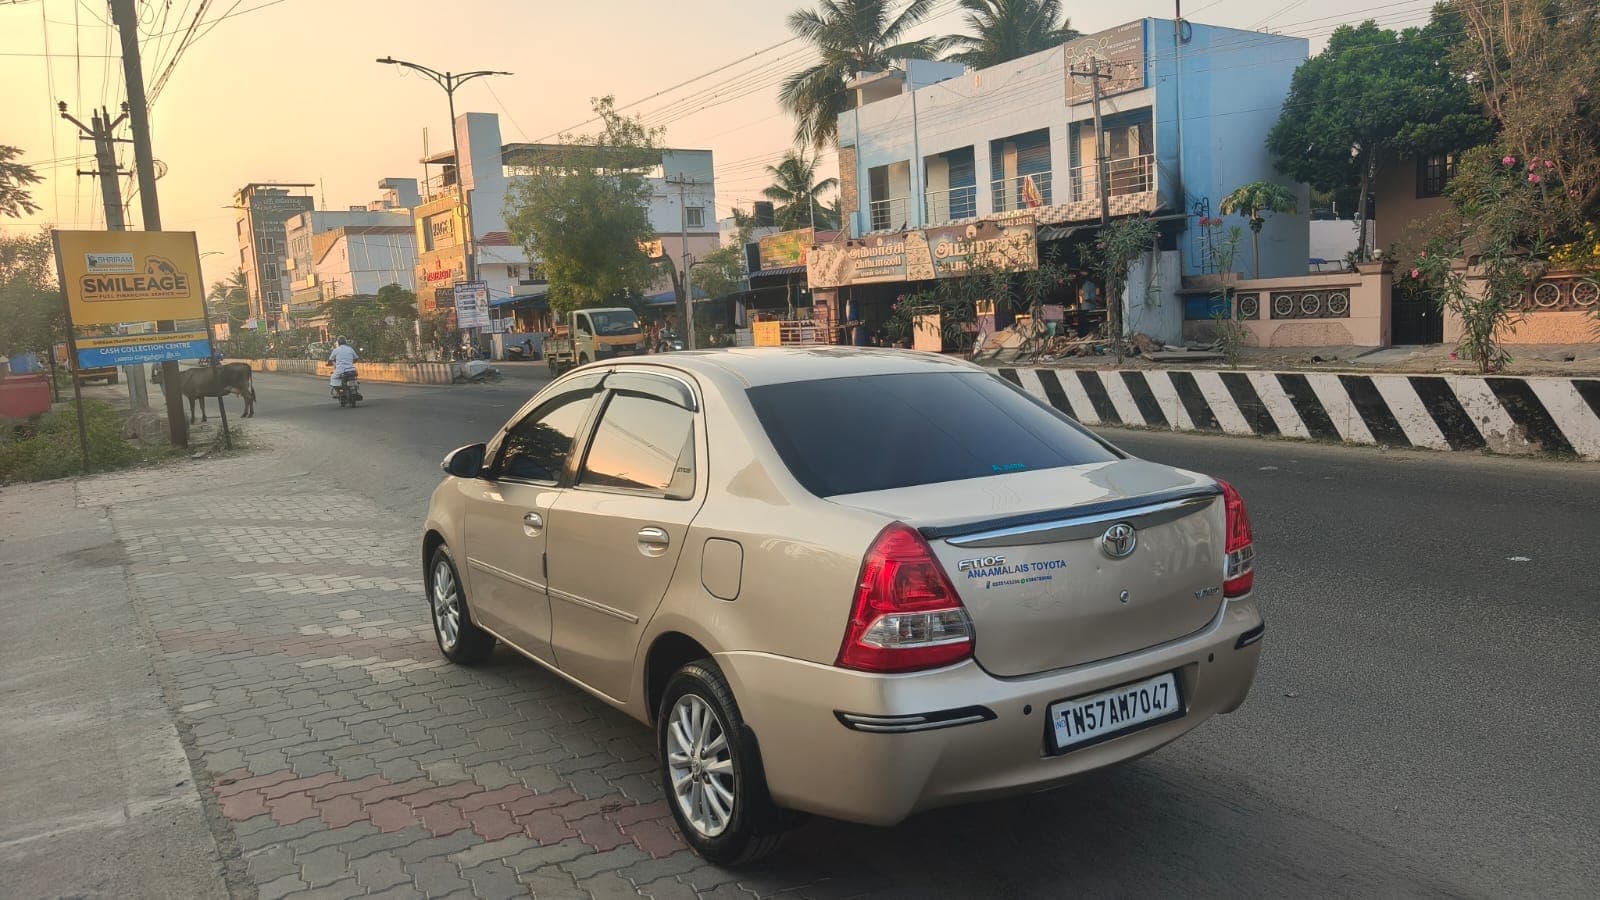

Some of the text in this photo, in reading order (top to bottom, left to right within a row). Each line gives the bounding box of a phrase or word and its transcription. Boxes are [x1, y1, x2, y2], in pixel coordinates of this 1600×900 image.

[847, 242, 905, 259] அம்மாச்சி
[97, 256, 133, 264] SHRIRAM
[84, 276, 187, 293] SMILEAGE
[99, 341, 192, 355] CASH COLLECTION CENTRE
[958, 555, 1007, 572] ETIOS
[967, 563, 1030, 579] ANAAMALAIS
[1031, 559, 1068, 573] TOYOTA
[1061, 682, 1168, 737] TN57AM7047
